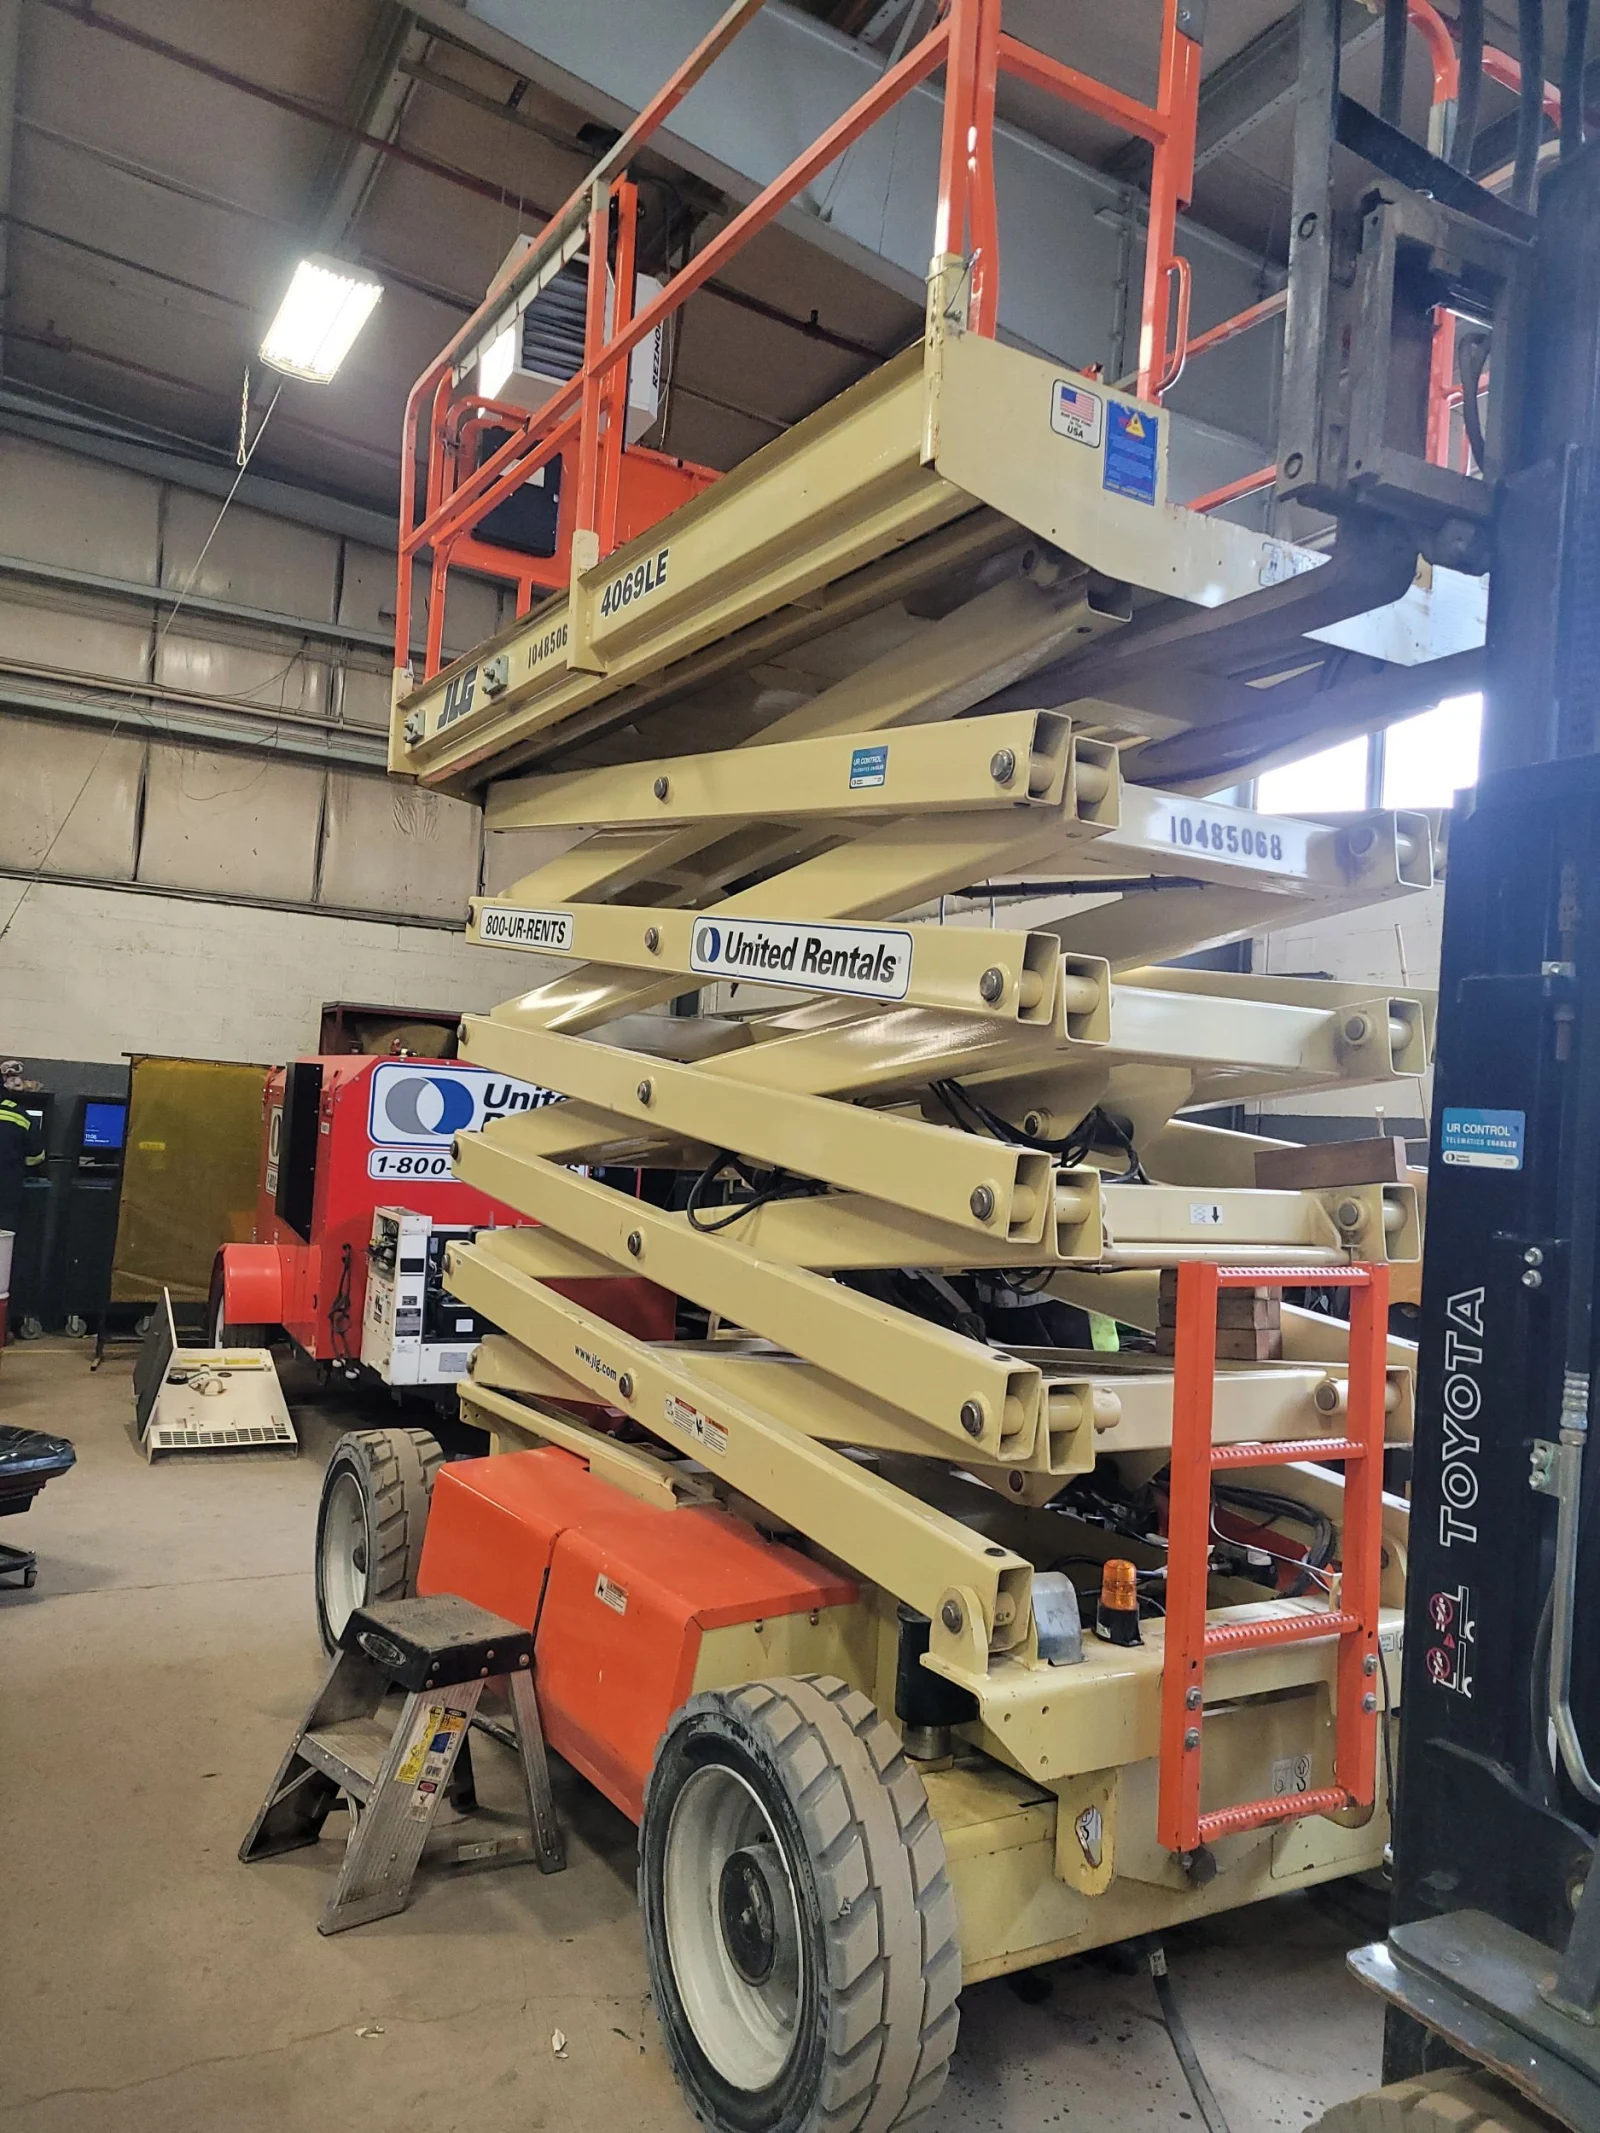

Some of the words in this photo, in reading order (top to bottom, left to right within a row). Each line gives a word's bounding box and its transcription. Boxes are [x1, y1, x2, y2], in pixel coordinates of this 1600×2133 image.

[652, 323, 662, 390] REZNO
[1067, 425, 1084, 439] USA
[600, 549, 670, 618] 4069LE
[527, 624, 568, 669] 1048506
[437, 665, 479, 731] JLG
[1170, 815, 1283, 861] 10485068
[485, 915, 566, 944] 800-UR-RENTS
[724, 930, 799, 971] United
[800, 937, 897, 984] Rentals
[1446, 1122, 1461, 1133] UR
[1462, 1123, 1511, 1137] CONTROL
[1446, 1136, 1485, 1146] TELEMATICS
[1487, 1139, 1518, 1149] ENABLED
[376, 1156, 452, 1175] 1-800-
[574, 1344, 617, 1382] www.jlg.com
[1440, 1286, 1485, 1548] TOYOTA
